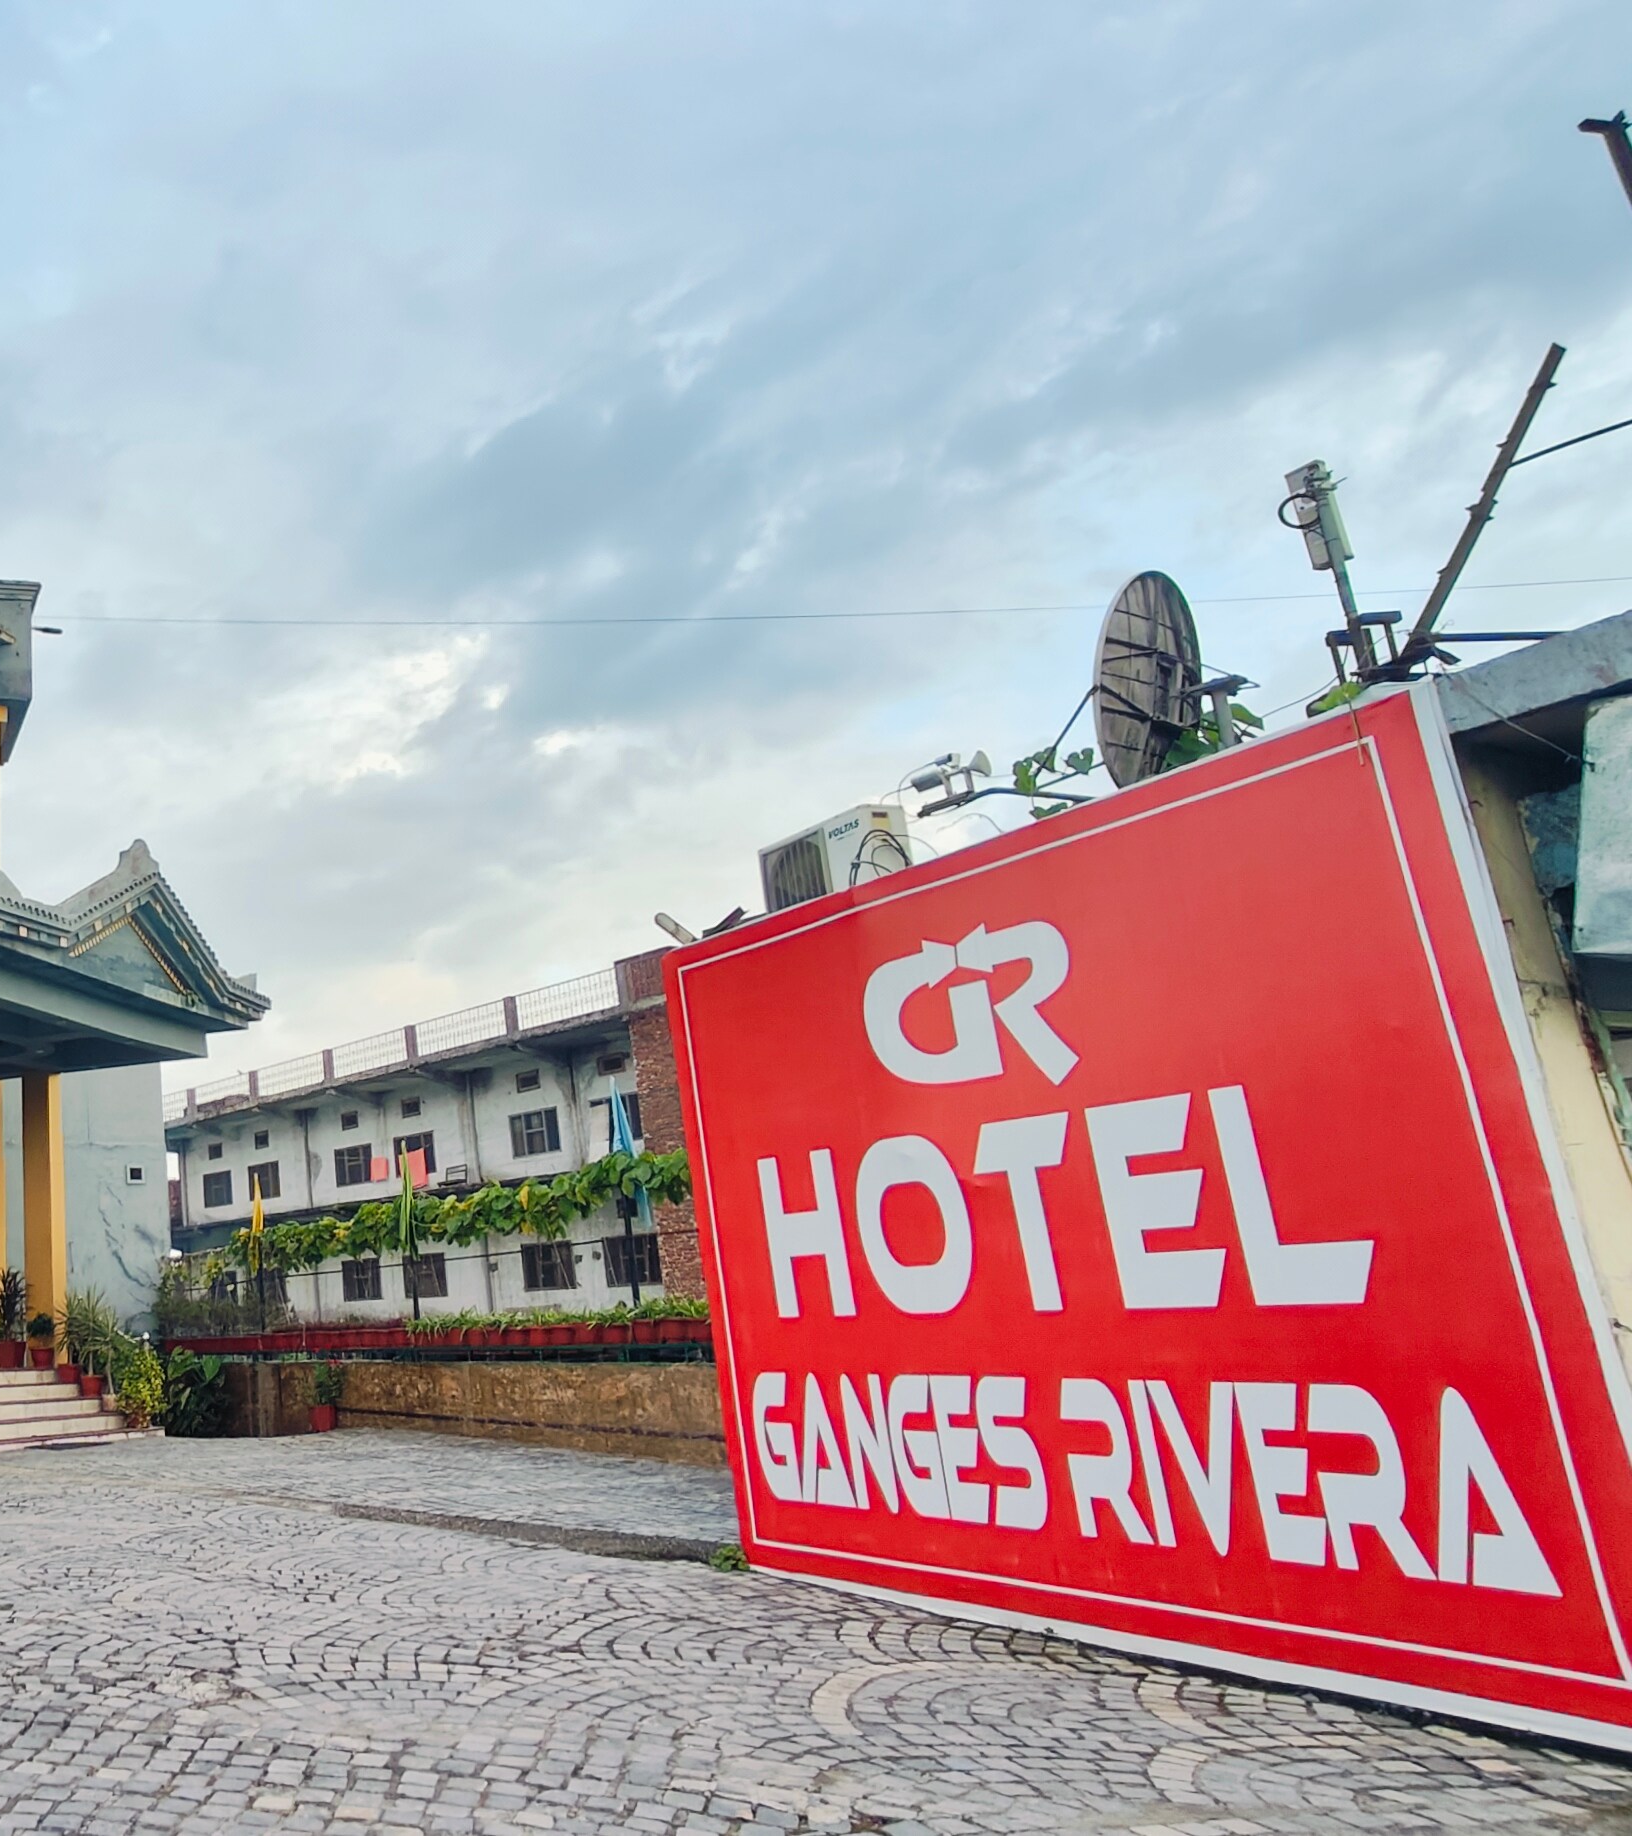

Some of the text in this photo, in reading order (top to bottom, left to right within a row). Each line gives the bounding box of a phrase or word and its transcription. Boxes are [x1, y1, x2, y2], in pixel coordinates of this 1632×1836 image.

[828, 818, 859, 839] VOLTAS
[862, 920, 1079, 1086] GR
[757, 1085, 1374, 1318] HOTEL
[752, 1372, 1563, 1597] GANGES RIVERA
